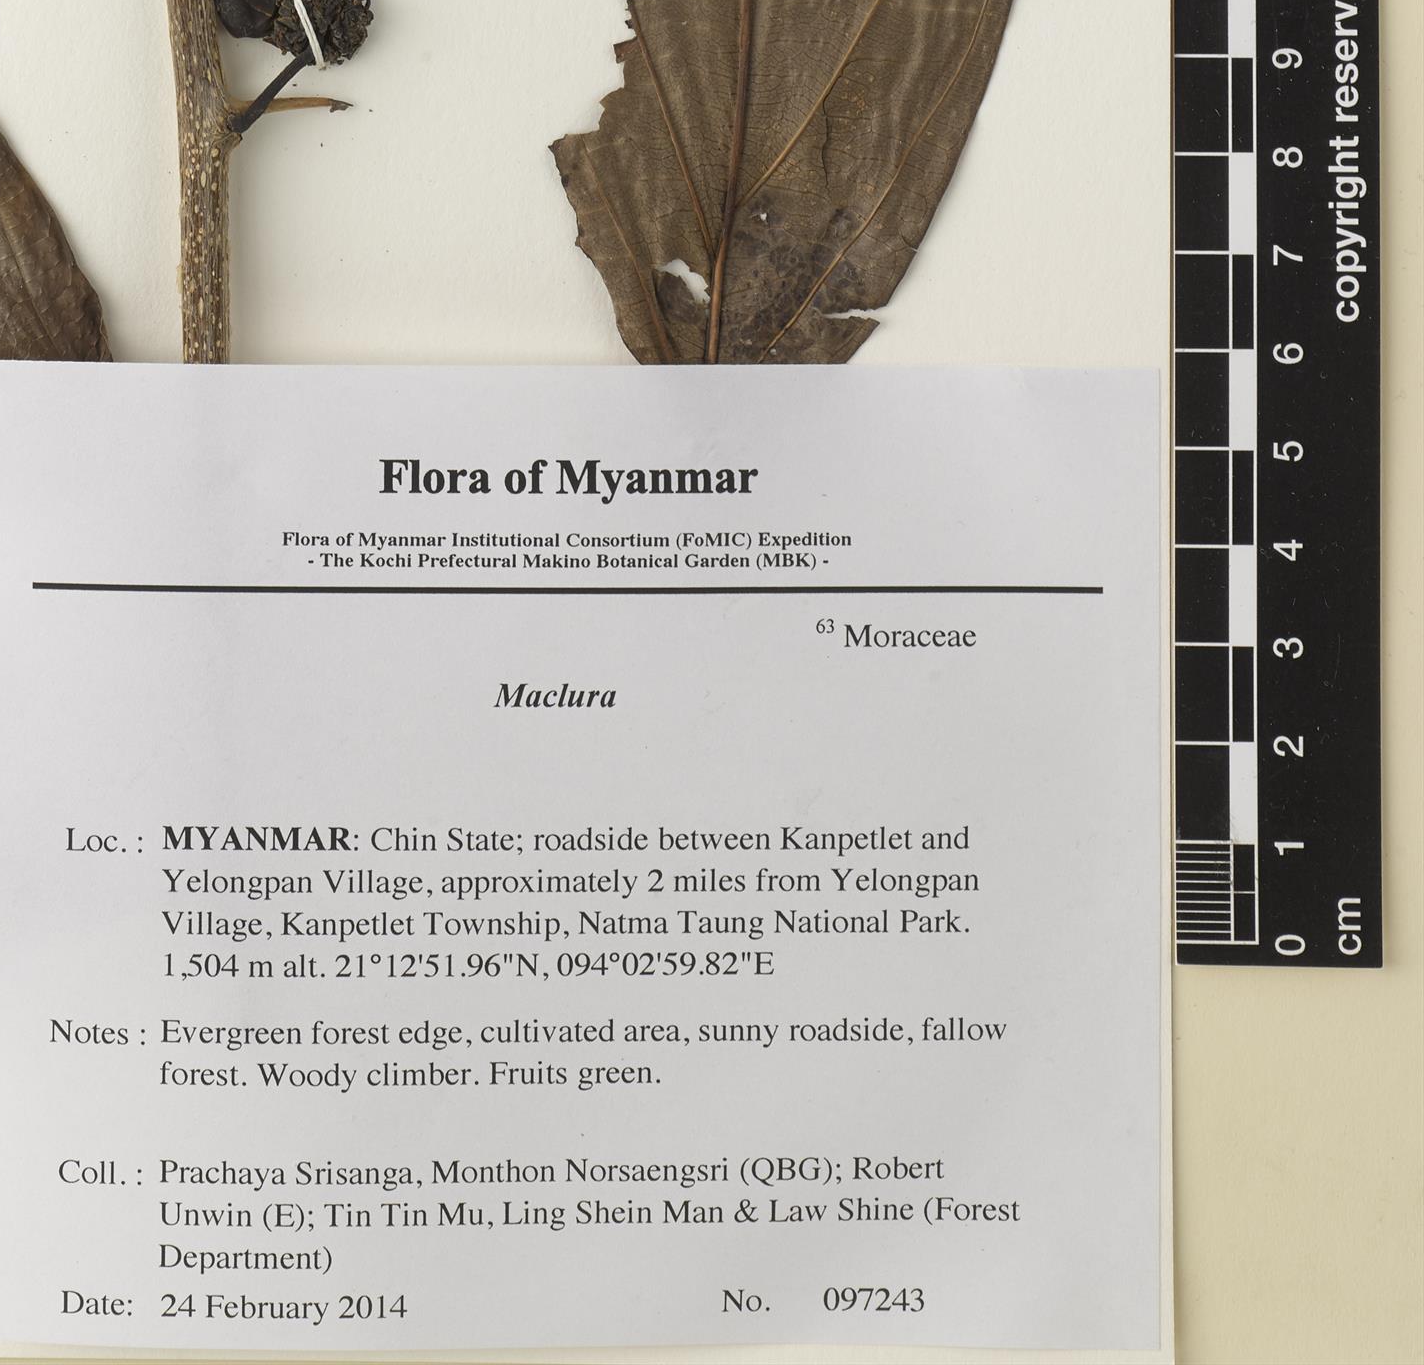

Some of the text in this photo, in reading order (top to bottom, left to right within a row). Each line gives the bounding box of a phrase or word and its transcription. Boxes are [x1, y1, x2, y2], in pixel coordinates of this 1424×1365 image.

[1271, 47, 1303, 70] 9
[1272, 146, 1304, 169] 8
[1327, 135, 1367, 323] copyright
[1272, 244, 1304, 266] 7
[1272, 342, 1304, 365] 6
[1272, 440, 1304, 462] 5
[378, 459, 759, 505] Flora of Myanmar
[282, 531, 852, 551] Flora of Myanmar Institutional Consortium (FoMIC) Expedition
[1272, 539, 1304, 562] 4
[319, 552, 817, 571] The Kochi Prefectural Makino Botanical Garden (MBK)
[815, 618, 977, 648] 63 Moraceae
[1272, 637, 1304, 659] 3
[493, 683, 617, 708] Maclura
[1272, 735, 1304, 758] 2
[66, 825, 970, 857] Loc. MYANMAR: Chin State; roadside between Kanpetlet and
[1273, 841, 1305, 856] 1
[161, 867, 980, 901] Yelongpan Village, approximately 2 miles from Yelongpan
[161, 908, 970, 943] Village, Kanpetlet Township, Natma Taung National Park.
[1337, 897, 1362, 956] cm
[1274, 934, 1306, 956] 0
[165, 953, 240, 981] 1,504
[248, 960, 274, 978] m
[283, 953, 326, 978] alt.
[50, 1016, 1007, 1051] Notes Evergreen forest edge, cultivated area, sunny roadside, fallow
[160, 1060, 661, 1094] forest. Woody climber. Fruits green.
[58, 1155, 945, 1192] Coll. Prachaya Srisanga, Monthon Norsaengsri (QBG); Robert
[160, 1196, 1021, 1233] Unwin (E); Tin Tin Mu, Ling Shein Man & Law Shine (Forest
[159, 1244, 333, 1275] Department)
[61, 1287, 925, 1326] Date: 24 February 2014 No. 097243
